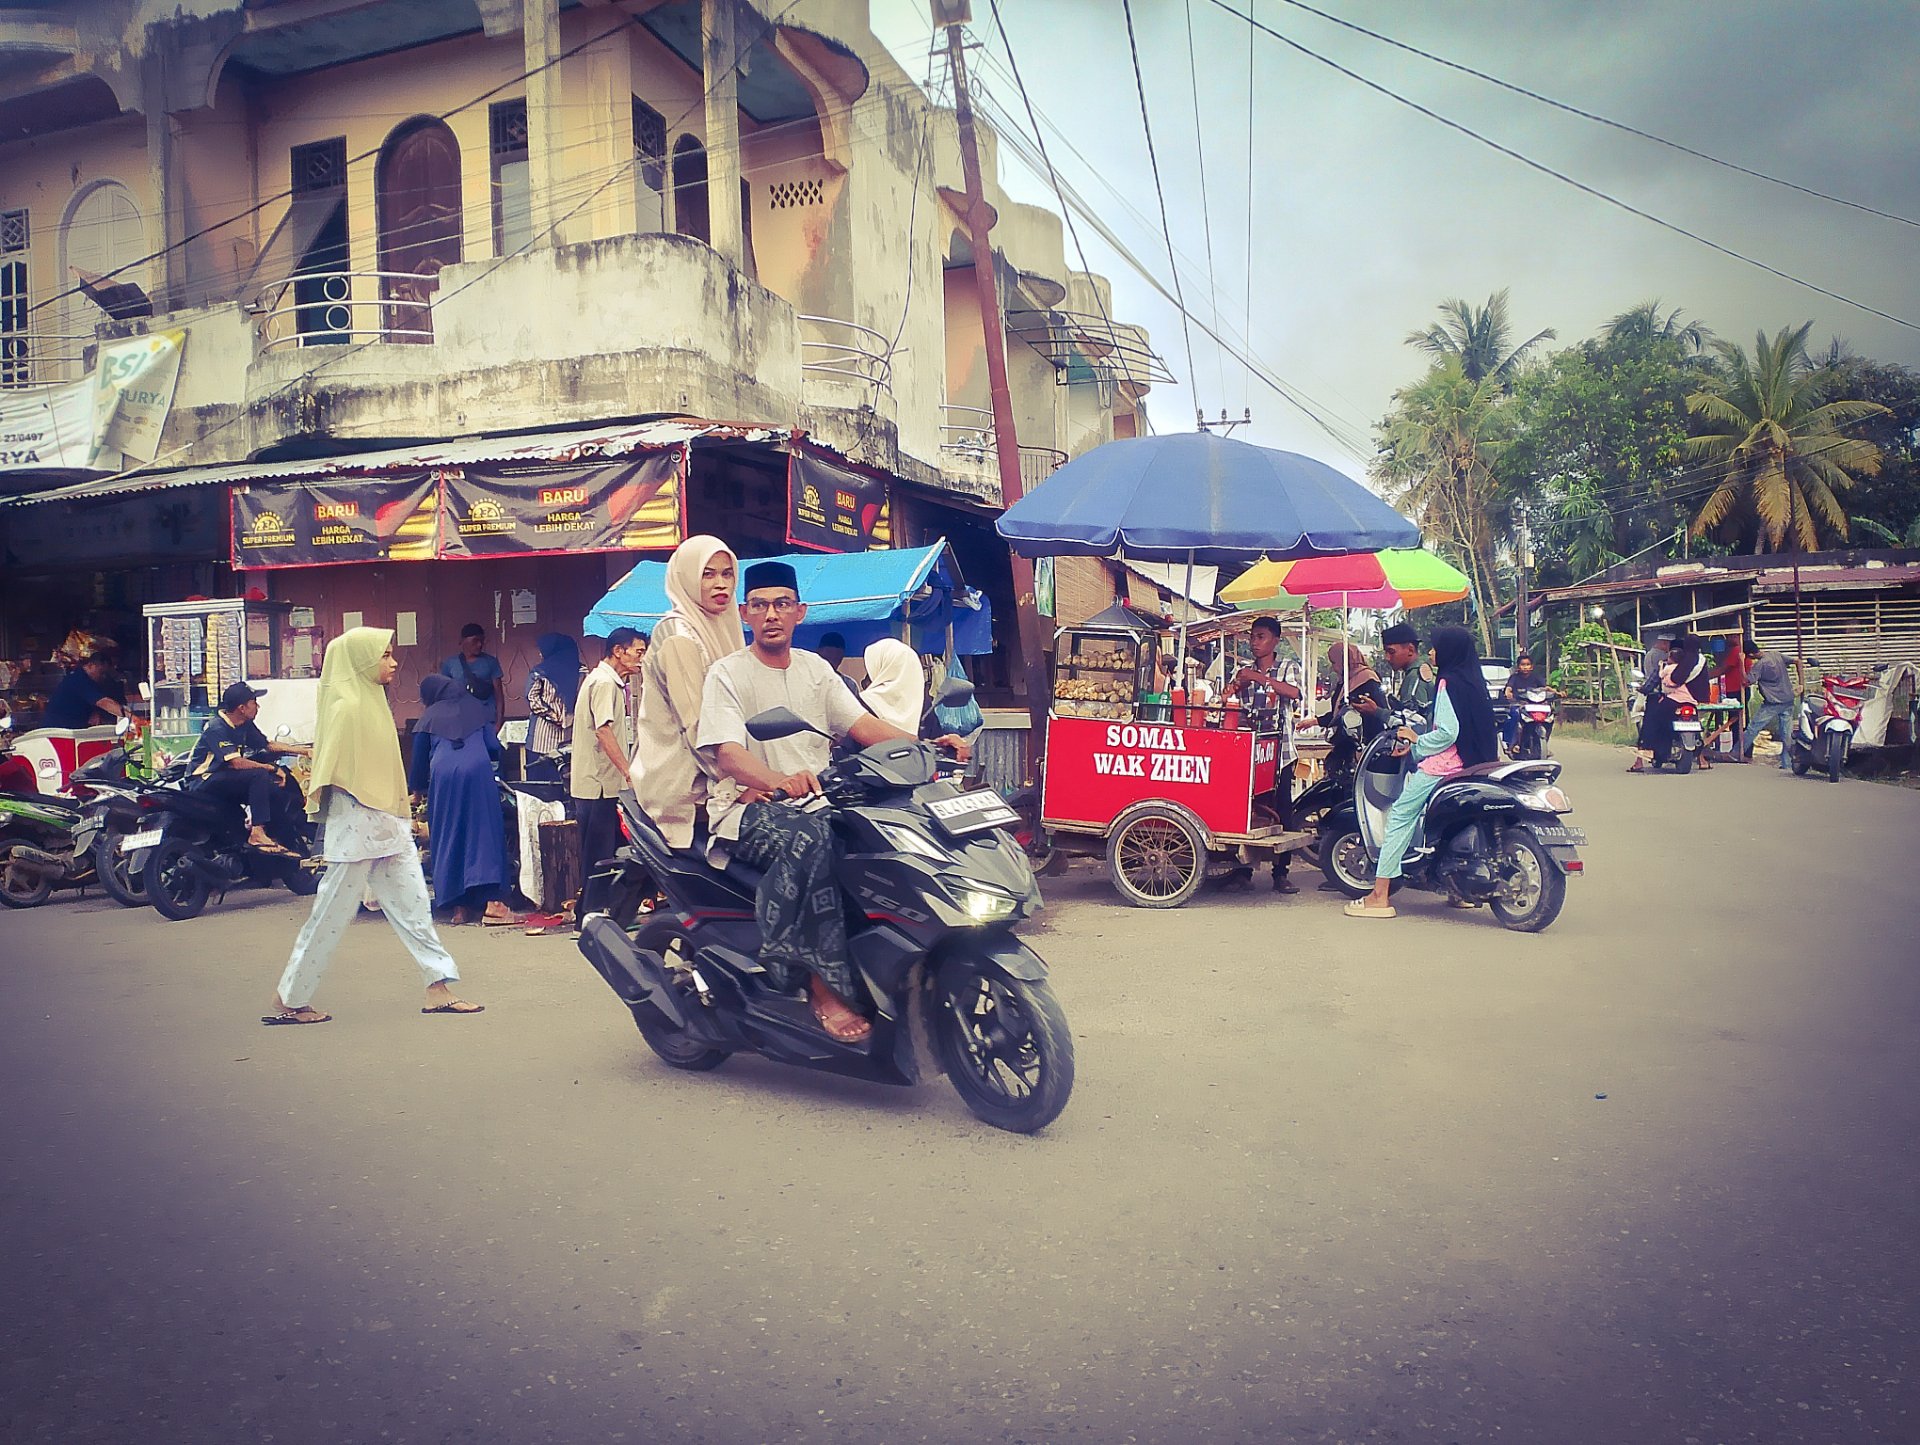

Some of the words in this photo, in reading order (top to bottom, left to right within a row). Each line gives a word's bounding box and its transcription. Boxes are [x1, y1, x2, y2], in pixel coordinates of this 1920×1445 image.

[542, 490, 585, 504] BARU
[837, 492, 855, 509] BARU
[317, 504, 355, 519] BARU
[547, 512, 582, 522] HARGA
[321, 526, 351, 535] HARGA
[459, 524, 482, 533] SUPER
[482, 522, 516, 531] PREMIUM
[534, 524, 562, 533] LEBIH
[563, 521, 596, 532] DEKAT
[242, 536, 263, 545] SUPER
[263, 534, 296, 543] PREMIUM
[312, 536, 335, 546] LEBIH
[335, 534, 364, 544] DEKAT
[1093, 753, 1146, 777] WAK
[1150, 753, 1212, 784] ZHEN
